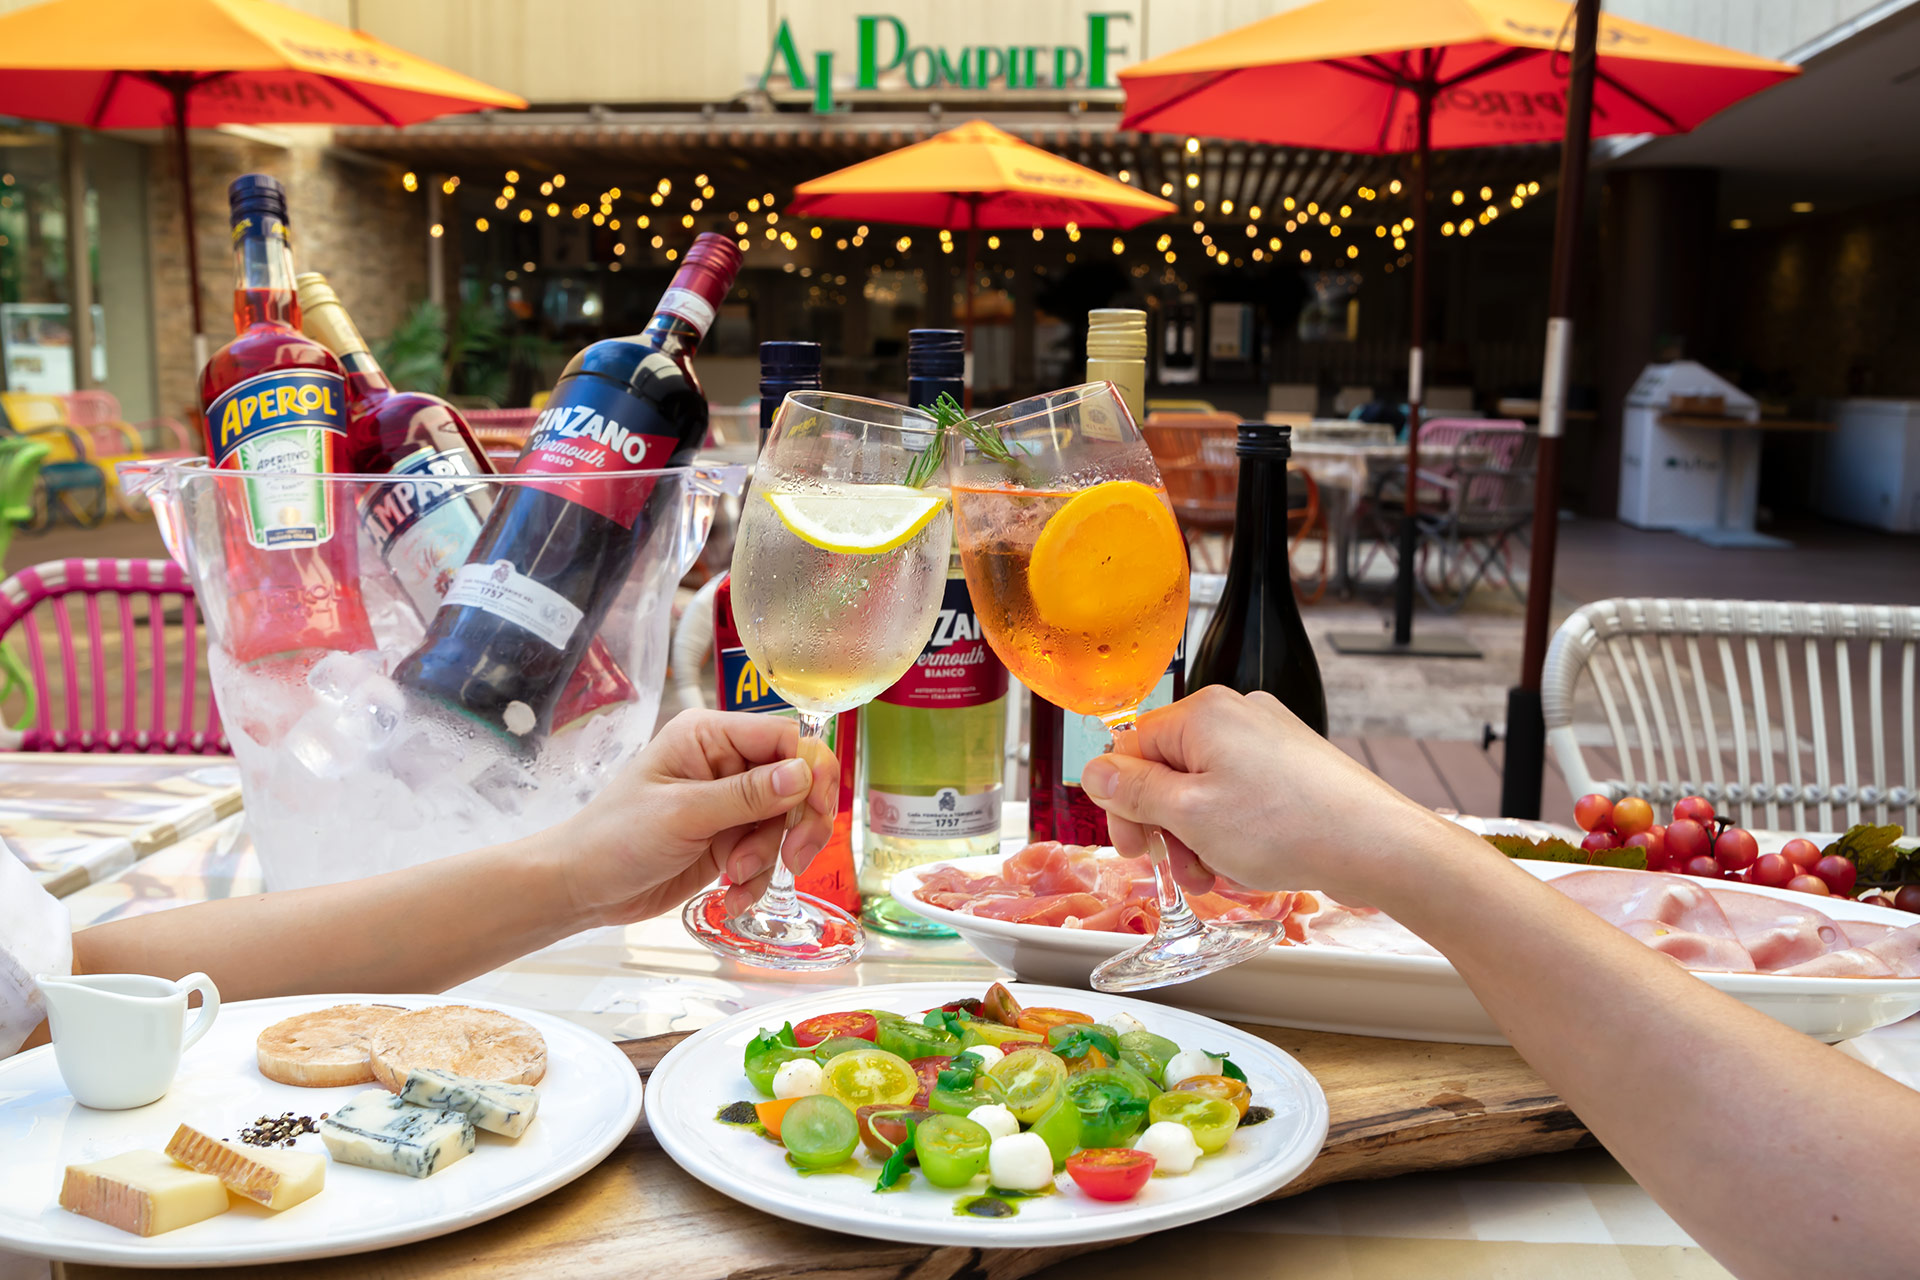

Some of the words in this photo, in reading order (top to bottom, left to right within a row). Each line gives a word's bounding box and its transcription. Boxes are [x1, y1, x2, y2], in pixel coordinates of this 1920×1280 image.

[221, 384, 338, 447] APEROL
[529, 405, 647, 464] CINZANO
[531, 432, 608, 469] Vermouth
[541, 453, 574, 468] ROSSO
[364, 454, 472, 553] AMPARI
[479, 586, 505, 600] 1757
[916, 644, 987, 667] ermouth
[924, 667, 966, 679] BIANCO
[935, 818, 960, 828] 1757
